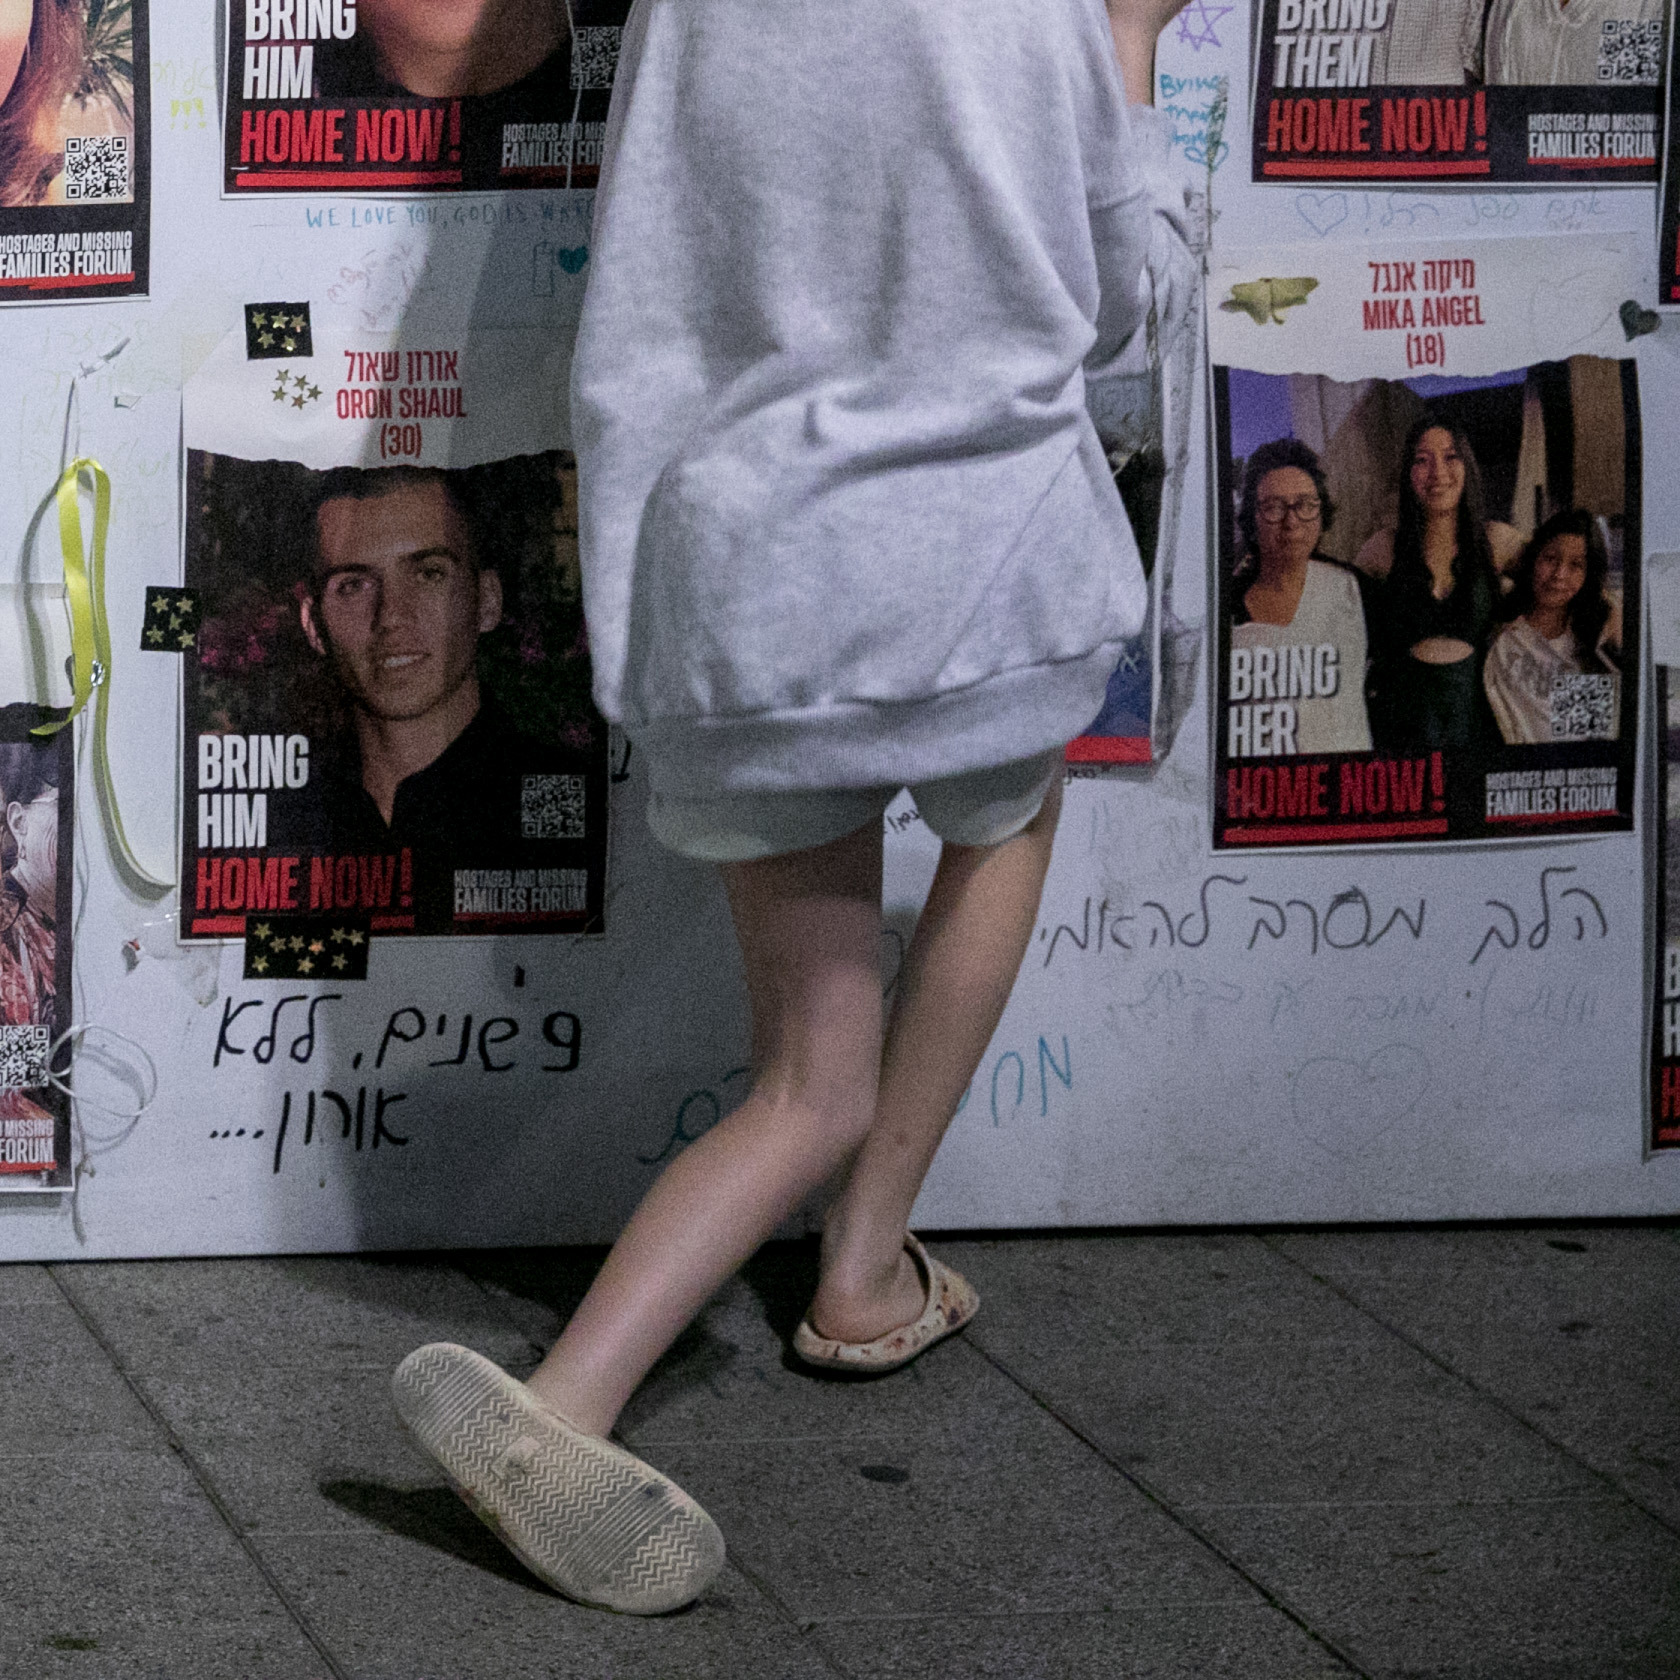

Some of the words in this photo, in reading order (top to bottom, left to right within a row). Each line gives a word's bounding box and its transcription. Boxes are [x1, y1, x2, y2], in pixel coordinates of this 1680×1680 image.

[1362, 298, 1416, 331] MIKA
[1421, 294, 1484, 327] ANGEL
[1405, 332, 1446, 369] (18)
[335, 387, 392, 421] ORON
[398, 386, 467, 420] SHAUL
[379, 423, 423, 459] (30)
